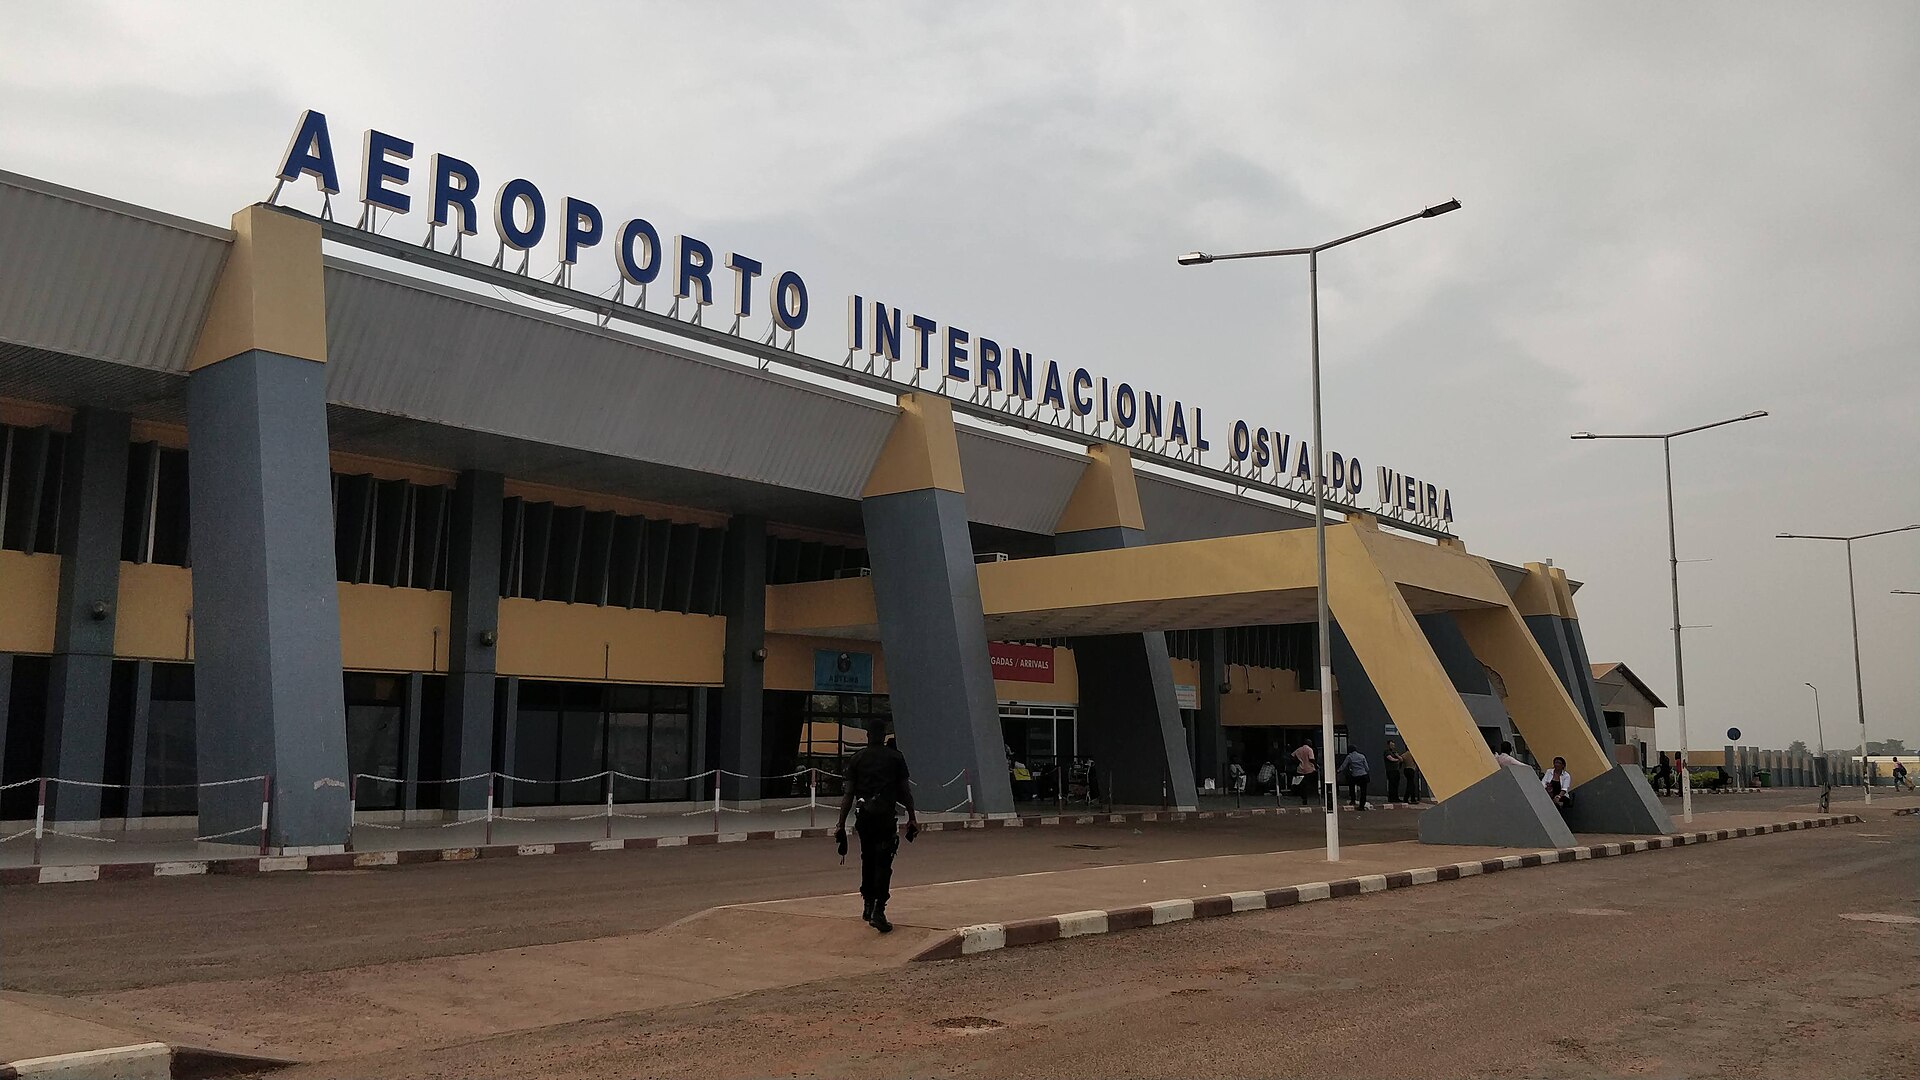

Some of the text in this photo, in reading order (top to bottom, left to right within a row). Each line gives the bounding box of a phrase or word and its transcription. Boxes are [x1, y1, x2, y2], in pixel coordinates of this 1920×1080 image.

[275, 109, 809, 331] AEROPORTO
[847, 294, 1210, 451] INTERNACIONAL
[1376, 465, 1454, 523] VIEIRA
[990, 656, 1013, 667] GADAS
[1020, 659, 1049, 669] ARRIVALS
